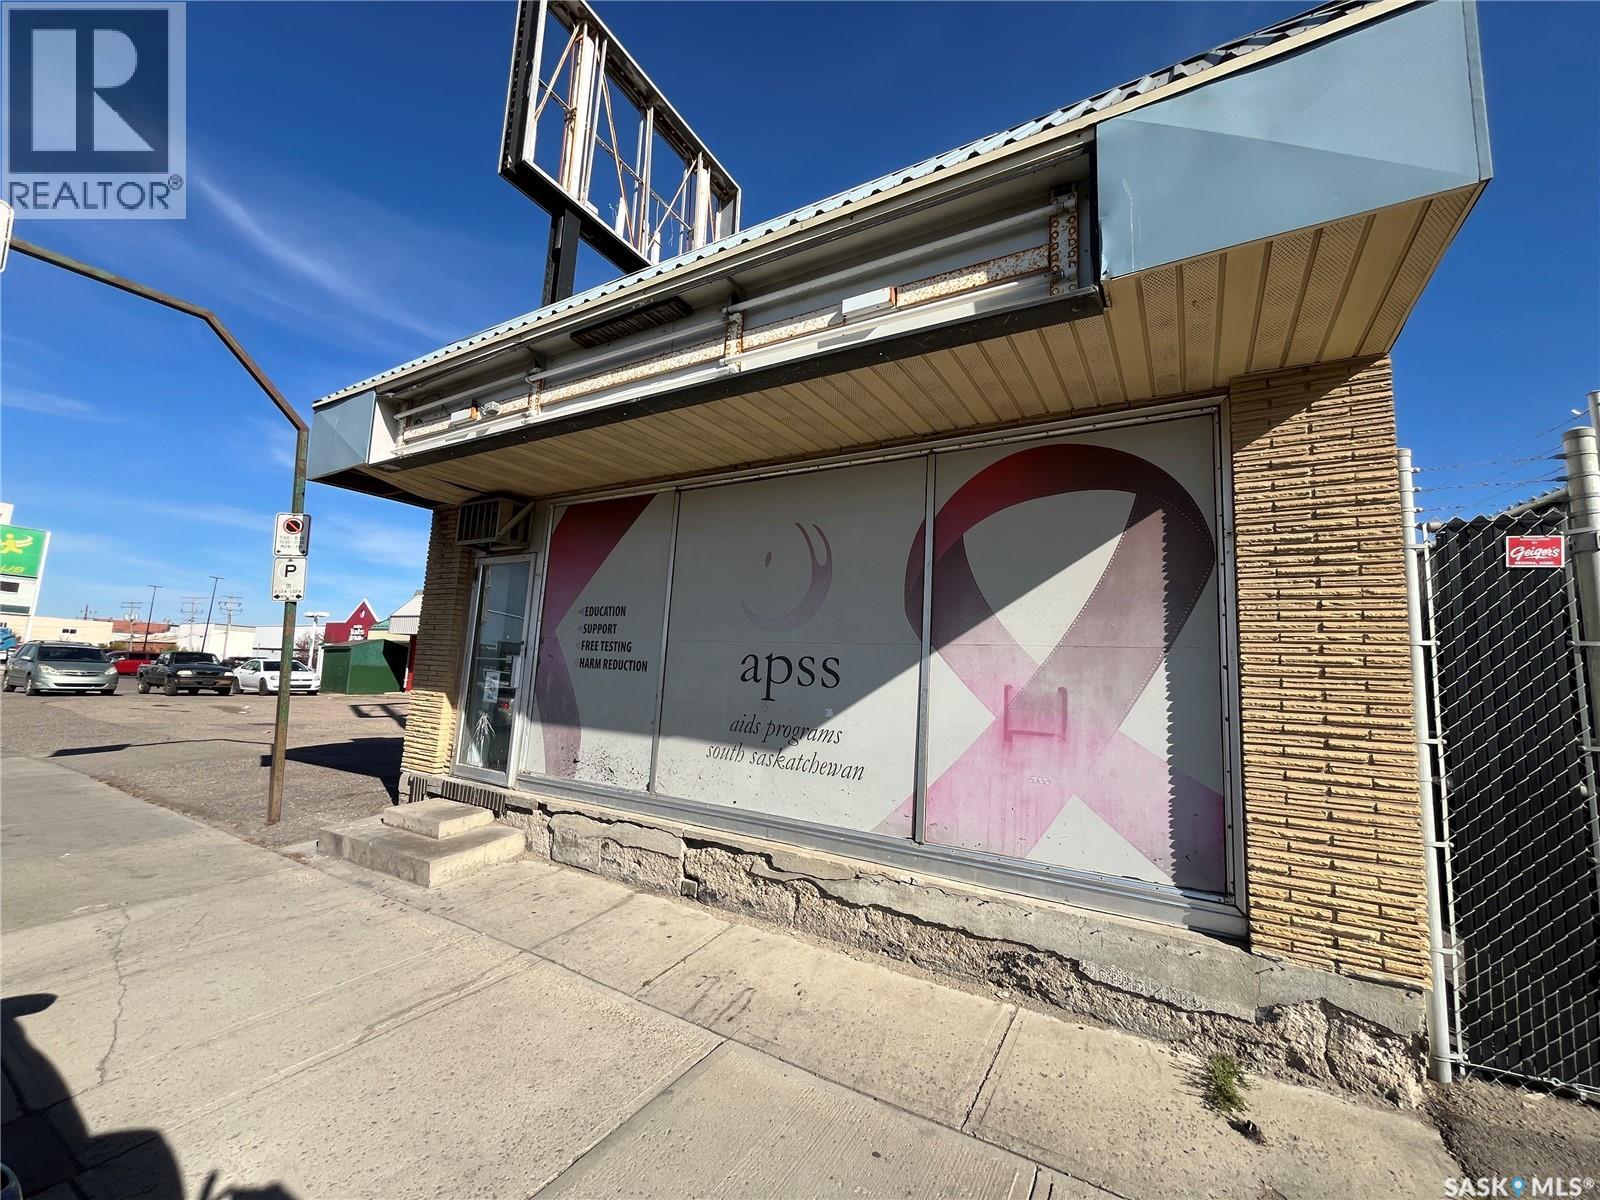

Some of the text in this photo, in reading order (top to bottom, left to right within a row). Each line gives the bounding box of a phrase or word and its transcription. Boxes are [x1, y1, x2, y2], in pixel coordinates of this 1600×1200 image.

[284, 564, 297, 578] P
[584, 605, 627, 617] EDUCATION
[582, 623, 618, 634] SUPPORT
[581, 640, 632, 653] FREE TESTING
[579, 657, 648, 673] HARM REDUCTION
[739, 652, 841, 702] apss
[729, 713, 843, 747] aids programs
[705, 742, 865, 781] south saskatchewan
